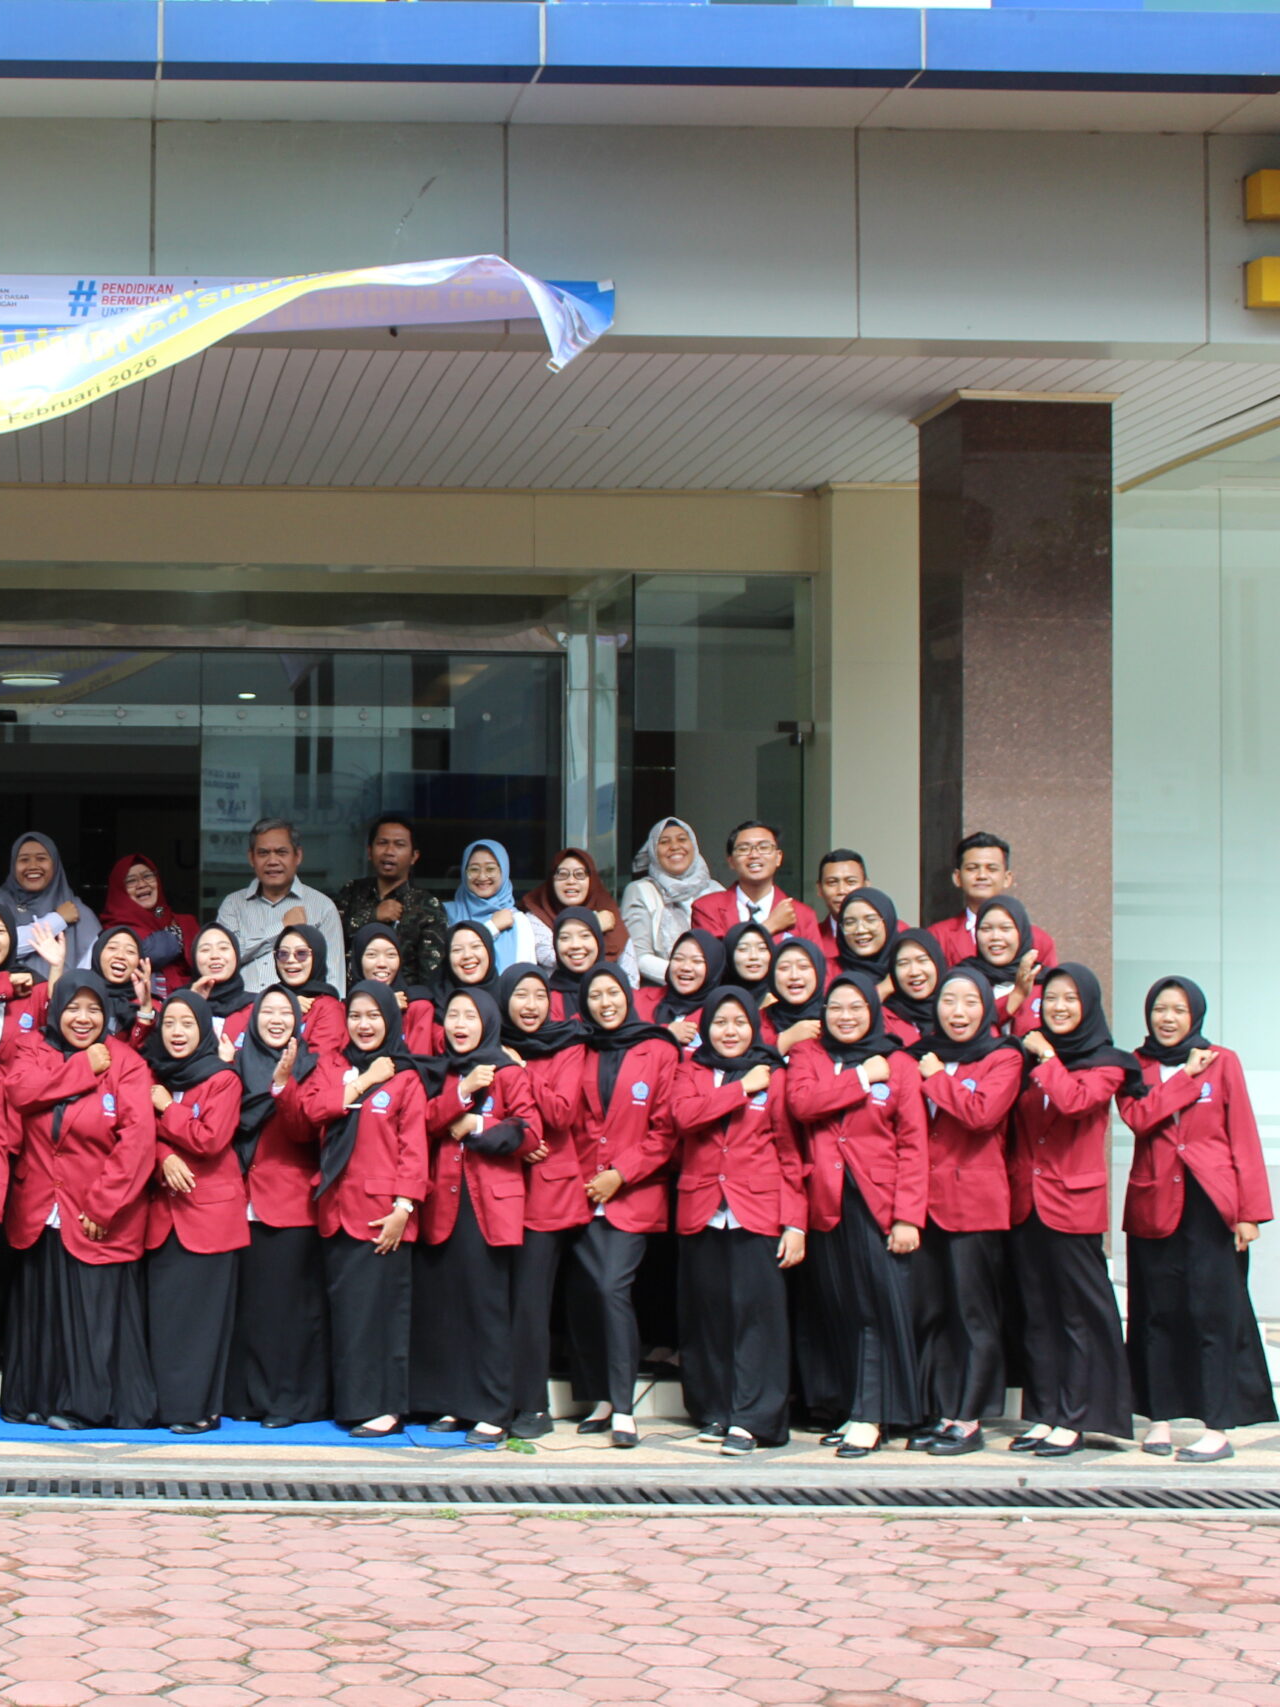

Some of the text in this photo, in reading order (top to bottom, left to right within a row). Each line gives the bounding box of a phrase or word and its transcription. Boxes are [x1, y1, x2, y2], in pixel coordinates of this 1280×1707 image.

[101, 283, 174, 294] PENDIDIKAN
[9, 385, 101, 424] Februari
[108, 356, 158, 387] 2026
